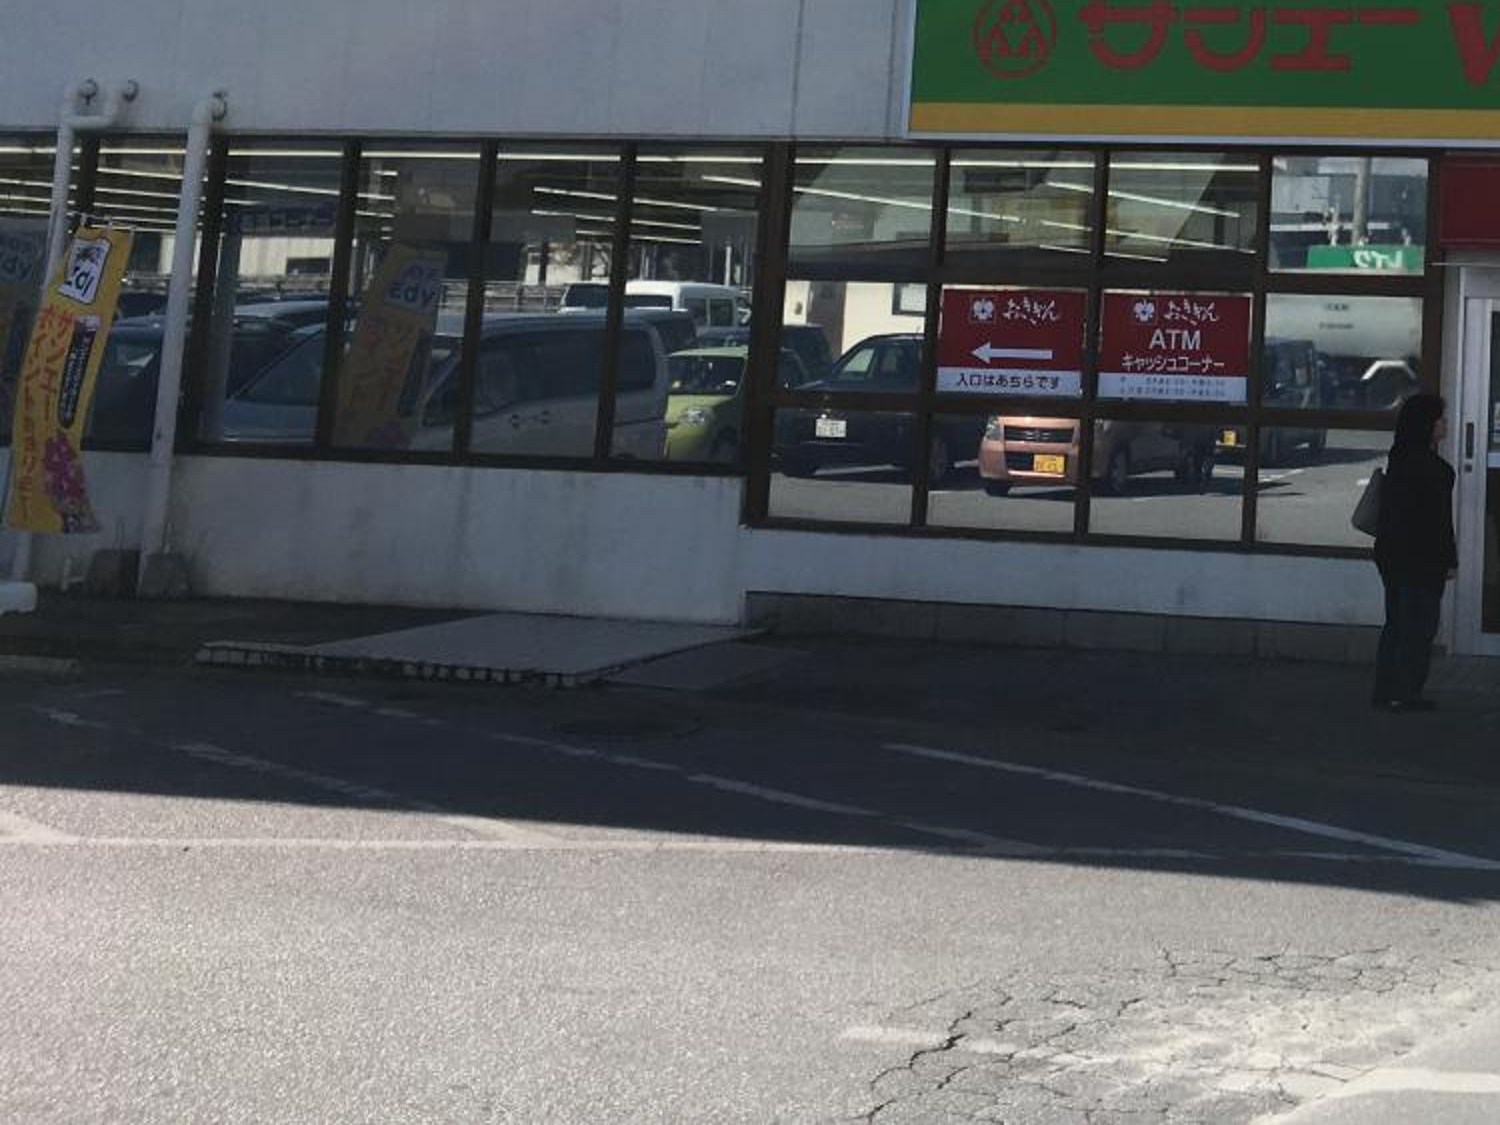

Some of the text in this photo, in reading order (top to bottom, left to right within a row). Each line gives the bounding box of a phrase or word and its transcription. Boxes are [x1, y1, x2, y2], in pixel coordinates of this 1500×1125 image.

[1149, 328, 1202, 351] ATM
[1121, 352, 1225, 372] キャッシュコーナー
